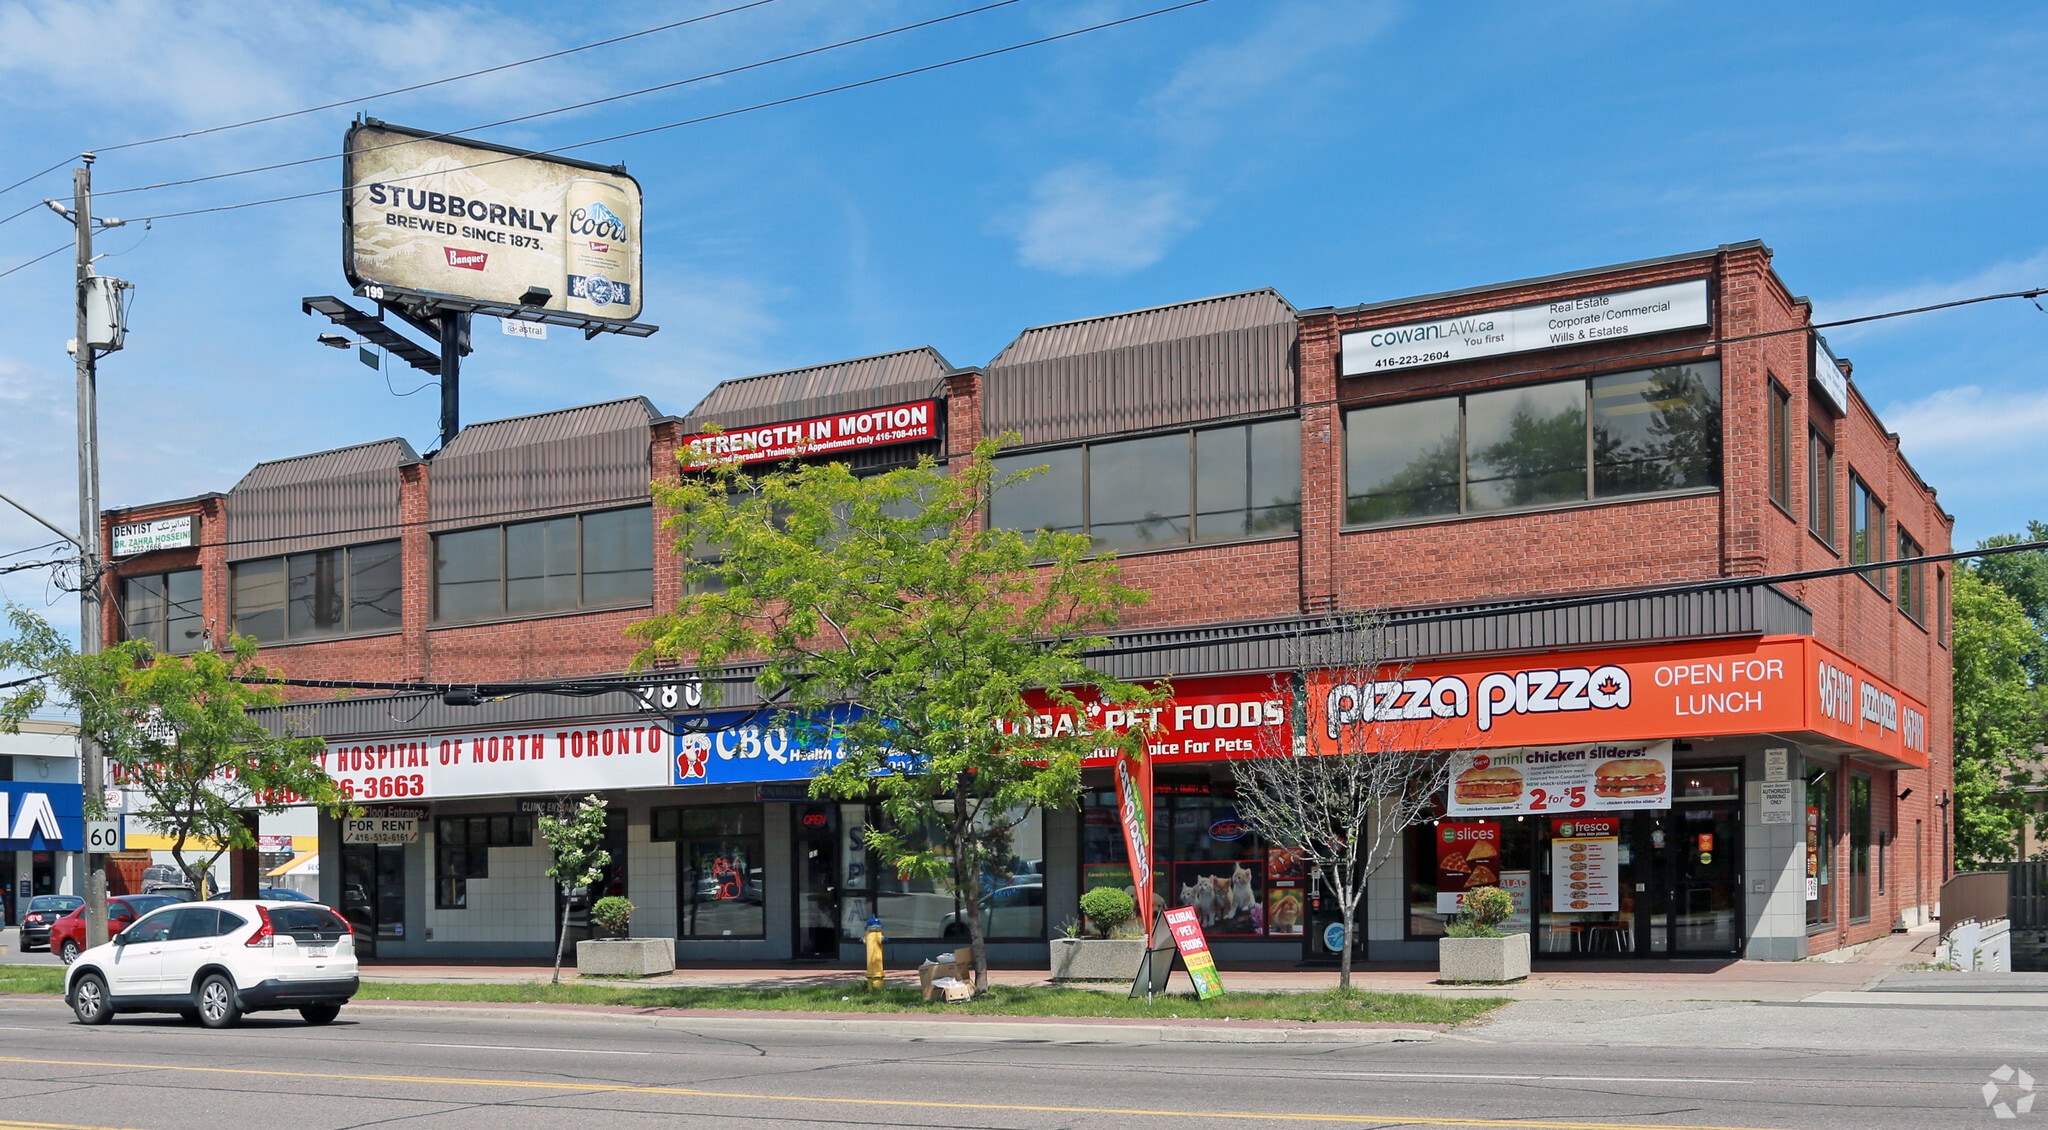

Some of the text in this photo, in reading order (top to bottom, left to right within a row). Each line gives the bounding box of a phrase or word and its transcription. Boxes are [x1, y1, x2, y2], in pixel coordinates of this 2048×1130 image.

[369, 183, 559, 233] STUBBORNLY
[386, 213, 544, 251] BREWED SINCE 1873.
[569, 207, 627, 243] Coors
[448, 250, 485, 268] Banquet
[364, 285, 384, 300] 199
[1550, 295, 1609, 315] Real Estate
[519, 325, 543, 336] astral
[1550, 323, 1629, 344] Wills & Estates
[1464, 333, 1505, 347] You first
[1375, 350, 1450, 368] 416-223-2604
[690, 405, 927, 456] STRENGTH IN MOTION
[766, 446, 796, 458] Training
[797, 444, 808, 454] by
[807, 438, 856, 453] Appointment
[857, 434, 874, 447] Only
[875, 426, 928, 442] 416-708-4115
[114, 522, 152, 538] DENTIST
[114, 540, 127, 549] DR.
[128, 536, 154, 547] ZAHRA
[155, 530, 190, 544] HOSSEINI
[1654, 659, 1784, 687] OPEN FOR
[1327, 664, 1631, 740] pizza pizza
[1675, 691, 1763, 716] LUNCH
[1860, 680, 1880, 733] pizza
[990, 700, 1285, 739] LOBAL PET FOODS
[147, 723, 174, 738] OFFICE
[337, 741, 429, 772] HOSPITAL
[439, 738, 464, 766] OF
[473, 734, 545, 764] NORTH
[556, 725, 661, 759] TORONTO
[715, 725, 788, 765] CBQ
[1184, 740, 1212, 754] For
[1215, 736, 1253, 752] Pets
[790, 748, 833, 762] Health
[836, 748, 847, 760] &
[1493, 746, 1648, 766] mini chicken sliders!
[322, 774, 424, 801] 6-3663
[1529, 786, 1587, 811] 2 for $5
[365, 806, 425, 819] Floor Entrance
[803, 814, 827, 826] OPEN
[349, 820, 414, 831] FOR RENT
[1209, 823, 1245, 836] OPEN
[1456, 827, 1494, 840] slices
[1575, 821, 1610, 832] fresco
[90, 828, 117, 846] 60
[354, 833, 409, 842] 416-512-6161
[1167, 910, 1196, 924] GLOBAL
[1179, 925, 1193, 936] PET
[1180, 937, 1204, 951] FOODS
